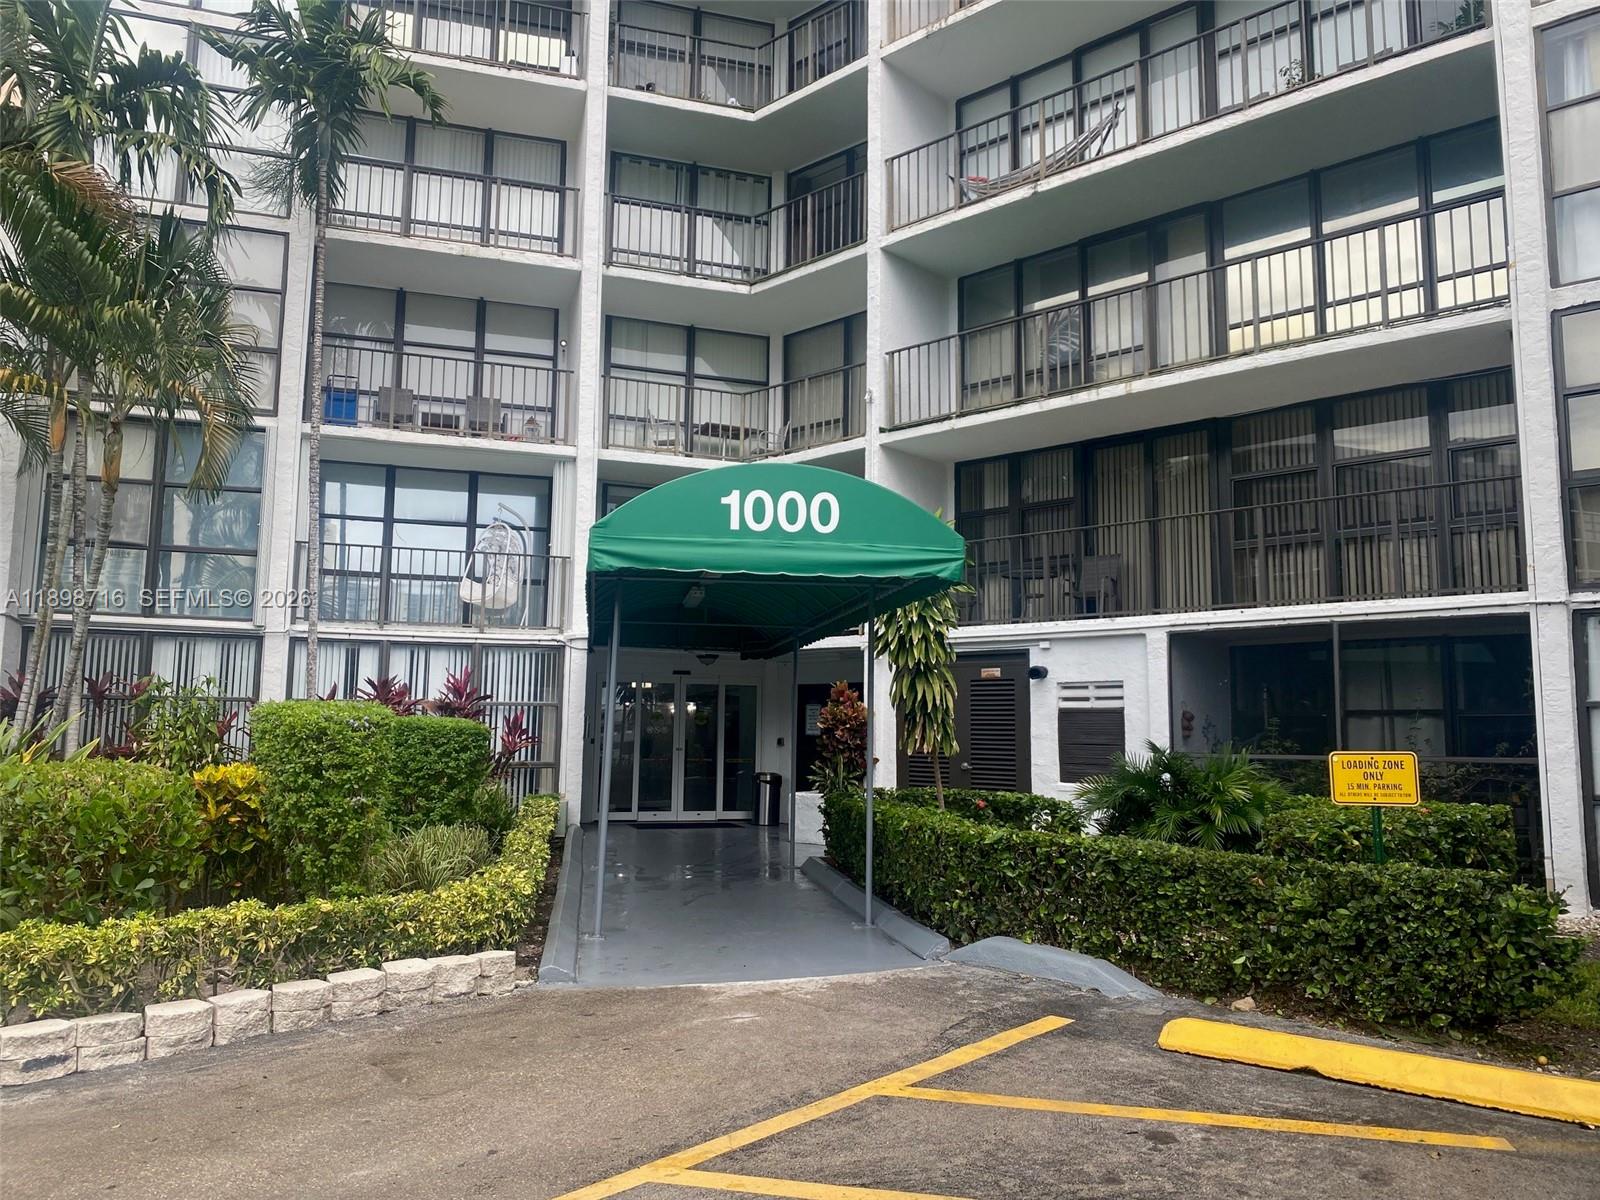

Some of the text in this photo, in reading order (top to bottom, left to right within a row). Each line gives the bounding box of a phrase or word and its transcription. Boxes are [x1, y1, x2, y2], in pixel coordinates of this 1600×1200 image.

[720, 489, 840, 534] 1000
[1341, 760, 1405, 770] LOADING ZONE
[1363, 771, 1384, 781] ONLY
[1356, 783, 1372, 791] MIN.
[1373, 783, 1403, 791] PARKING
